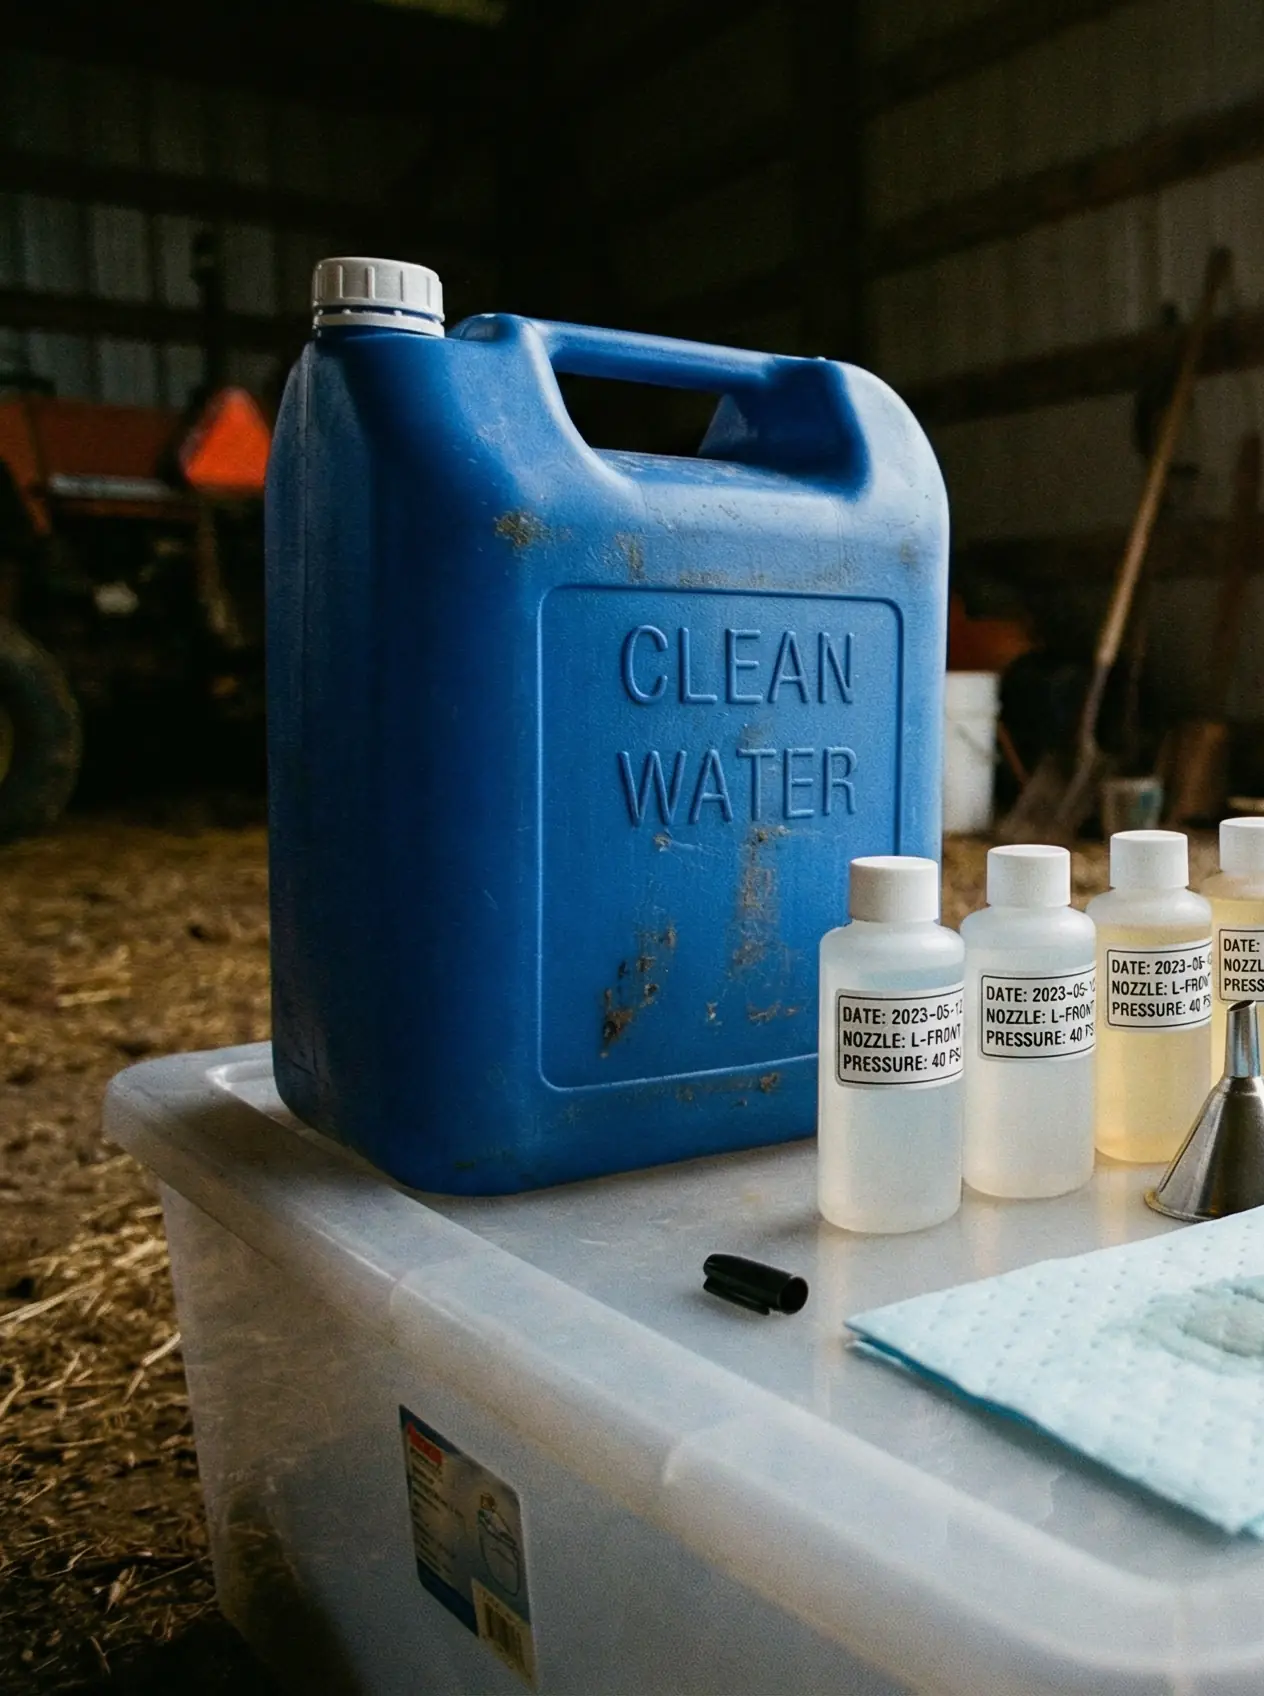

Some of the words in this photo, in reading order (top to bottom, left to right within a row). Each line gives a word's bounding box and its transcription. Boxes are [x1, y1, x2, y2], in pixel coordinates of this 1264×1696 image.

[620, 625, 855, 705] CLEAN
[617, 746, 858, 827] WATER
[1223, 938, 1260, 953] DATE:
[1112, 959, 1151, 975] DATE:
[986, 985, 1027, 1003] DATE:
[1112, 980, 1168, 996] NOZZLE:
[843, 1006, 886, 1025] DATE:
[986, 1008, 1046, 1025] NOZZLE:
[1112, 1001, 1186, 1018] PRESSURE:
[1189, 998, 1201, 1012] 40
[843, 1030, 906, 1049] NOZZLE:
[986, 1030, 1066, 1048] PRESSURE:
[1069, 1026, 1083, 1043] 40
[843, 1053, 928, 1073] PRESSURE:
[931, 1051, 946, 1068] 40
